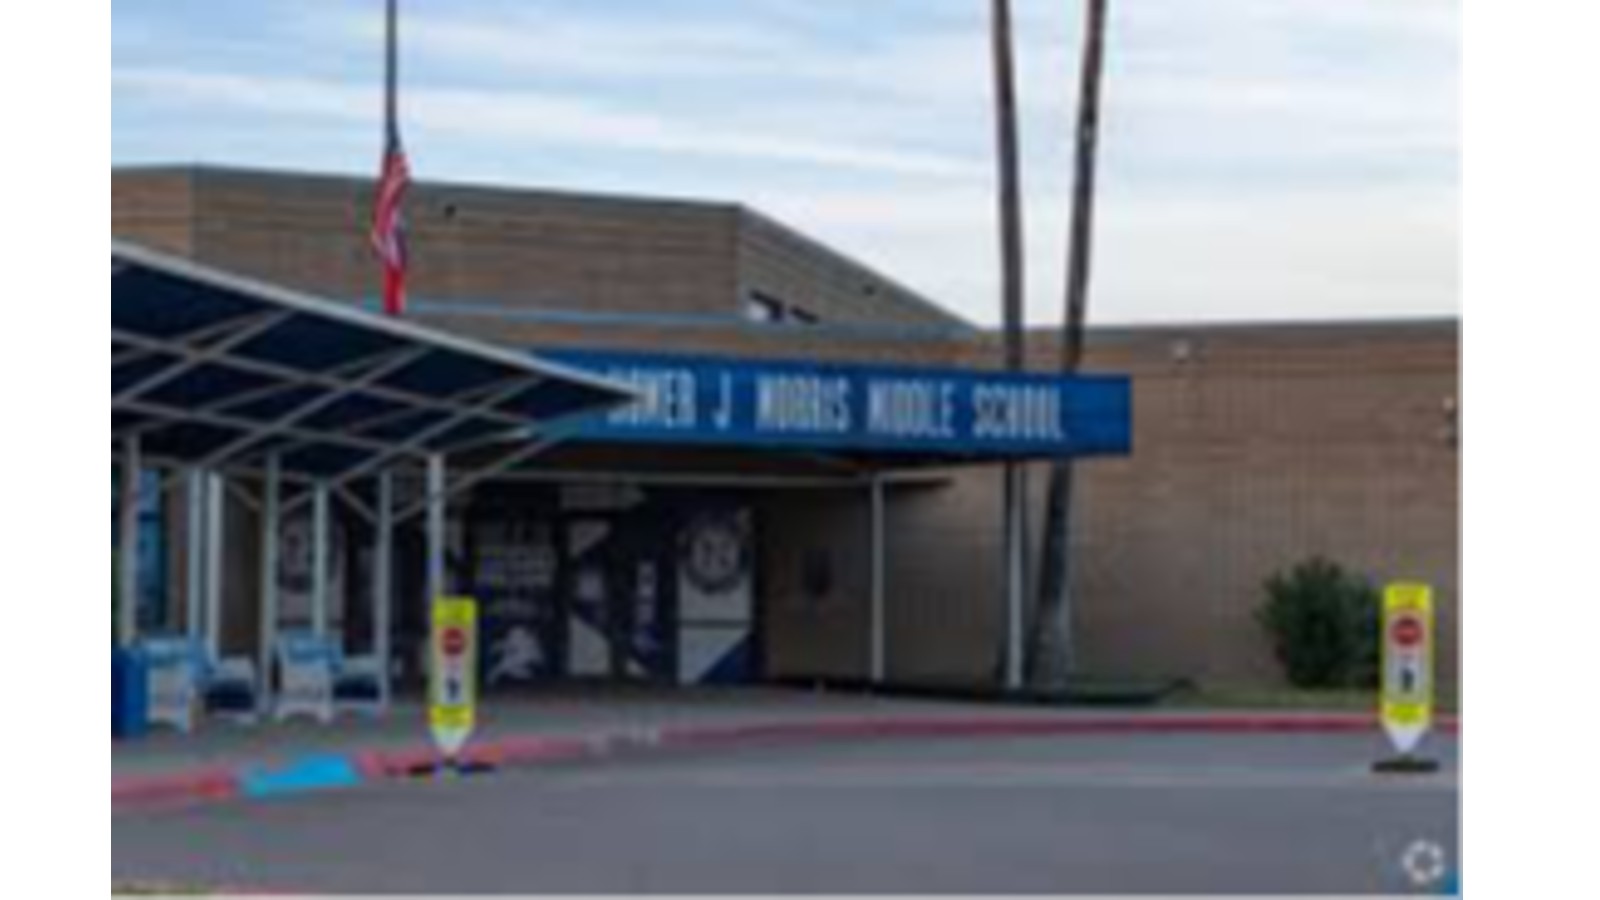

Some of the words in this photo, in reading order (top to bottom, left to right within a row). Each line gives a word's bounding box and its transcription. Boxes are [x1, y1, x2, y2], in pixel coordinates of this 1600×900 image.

[713, 370, 733, 430] J
[868, 379, 955, 438] MIDDLE
[973, 383, 1065, 441] SCHOOL
